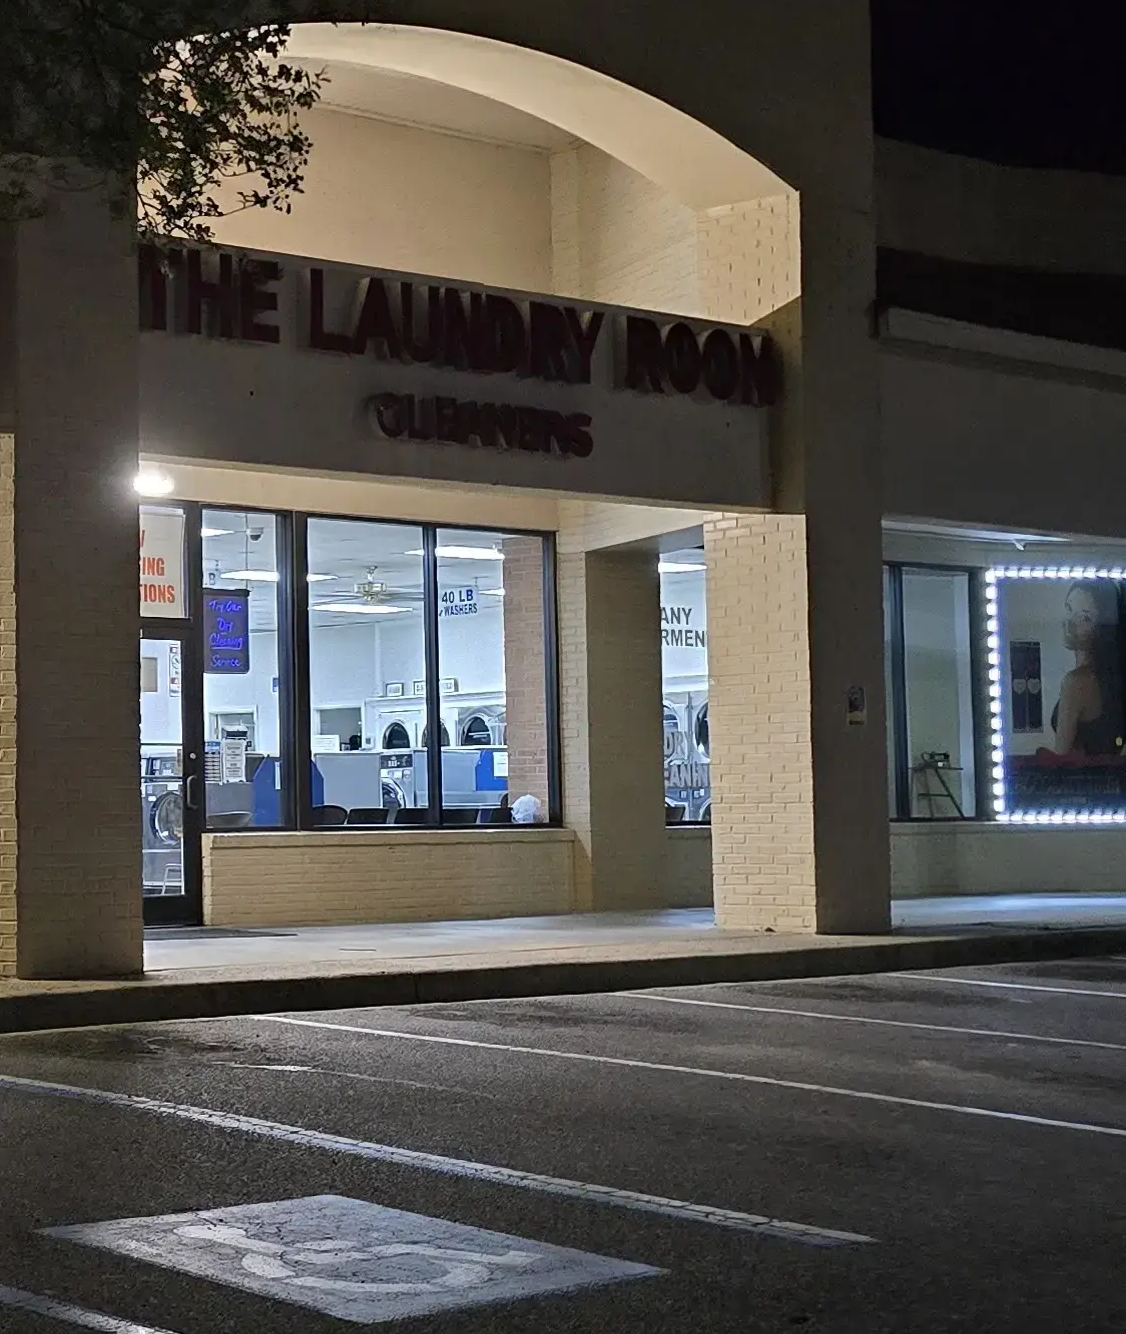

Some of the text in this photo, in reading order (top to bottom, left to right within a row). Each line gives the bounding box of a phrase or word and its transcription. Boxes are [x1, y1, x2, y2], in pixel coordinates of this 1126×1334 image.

[139, 244, 785, 409] THE LAUNDRY ROOM
[369, 392, 593, 458] CLEANERS
[142, 556, 165, 576] ING
[441, 589, 474, 604] 40 LB
[209, 599, 224, 613] Try
[444, 603, 478, 616] WASHERS
[217, 617, 233, 632] Dry
